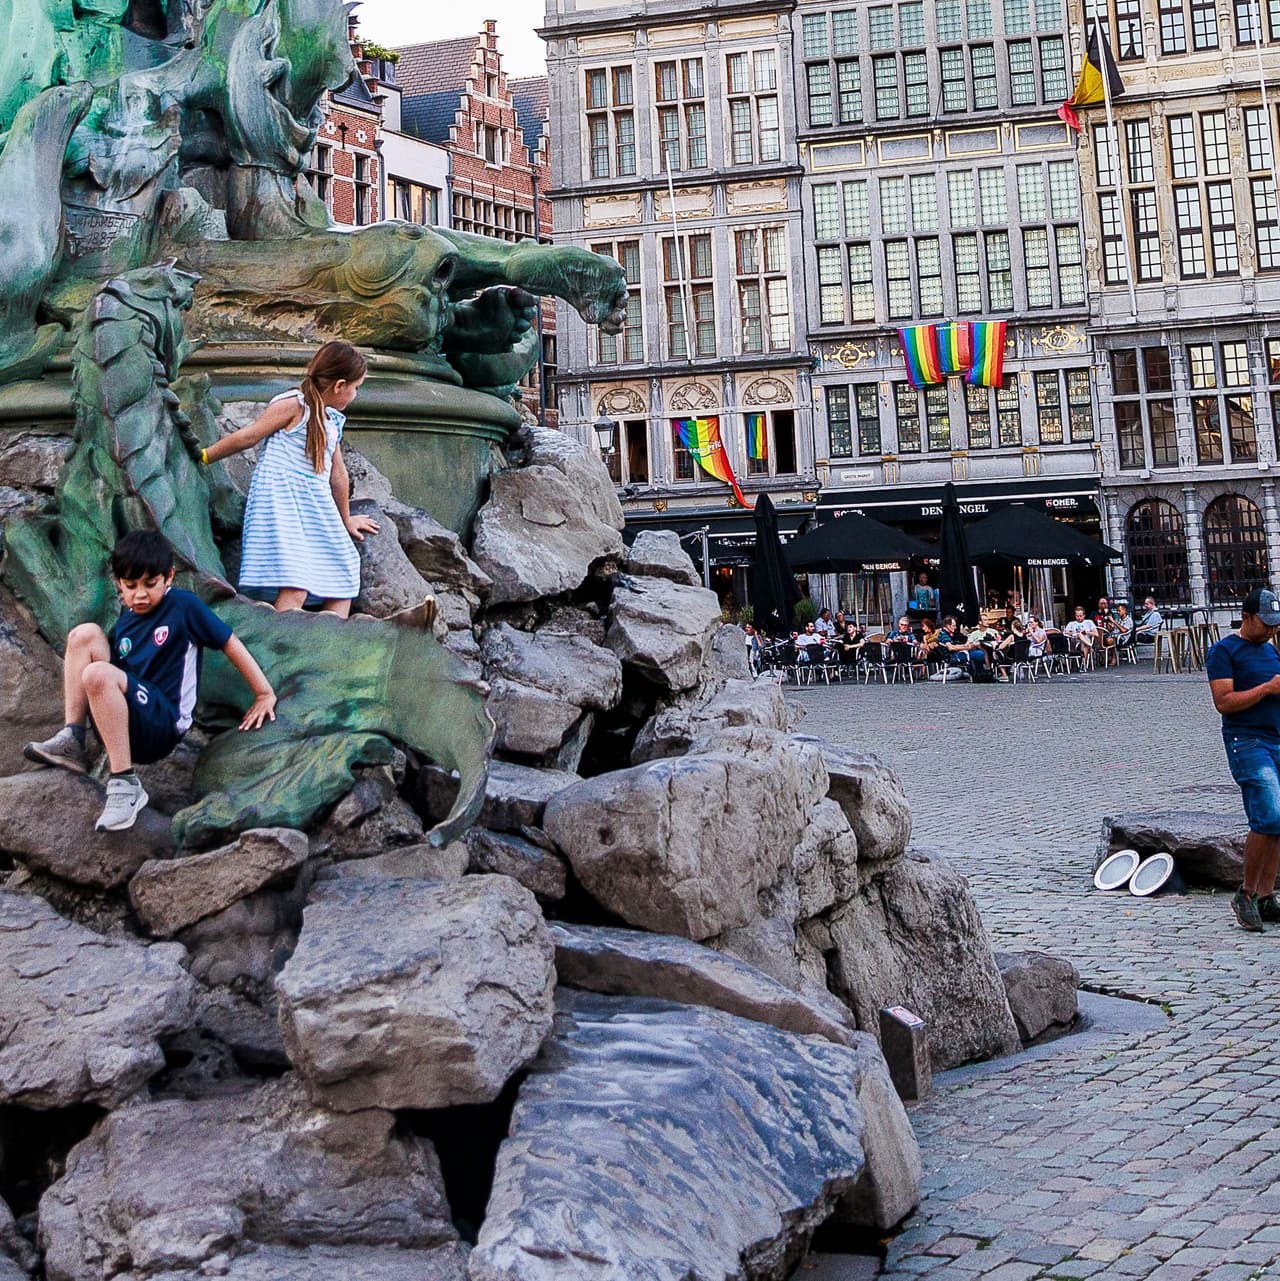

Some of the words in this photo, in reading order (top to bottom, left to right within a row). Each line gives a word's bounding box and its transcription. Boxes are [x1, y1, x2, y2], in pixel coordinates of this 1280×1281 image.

[921, 506, 943, 516] DEN
[959, 503, 989, 514] NGEL
[1028, 558, 1041, 566] DEN
[1042, 558, 1069, 566] BENGEL
